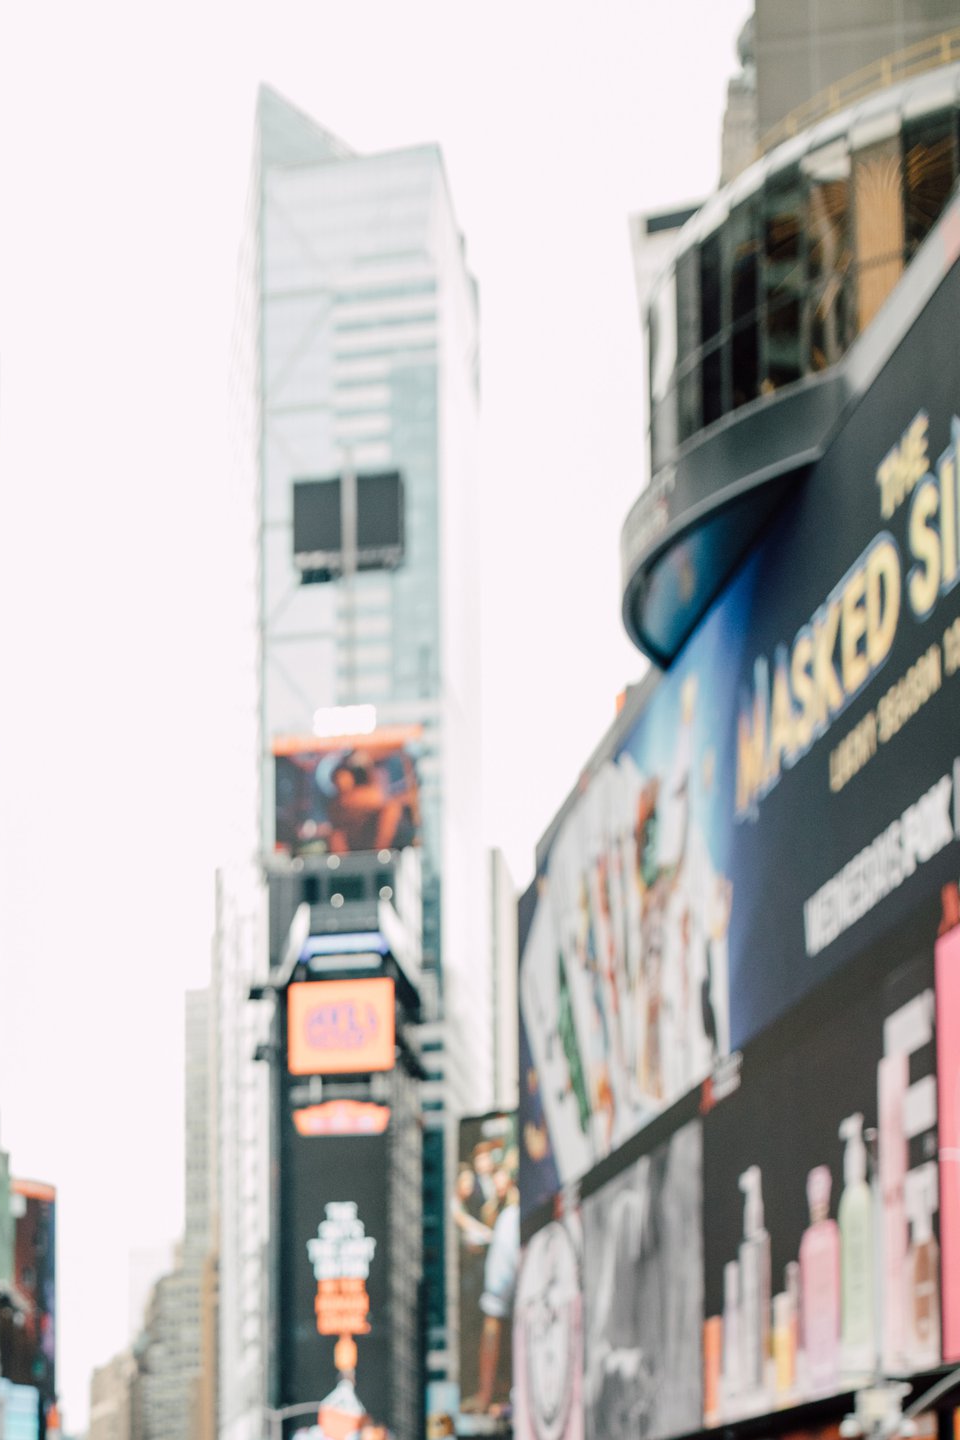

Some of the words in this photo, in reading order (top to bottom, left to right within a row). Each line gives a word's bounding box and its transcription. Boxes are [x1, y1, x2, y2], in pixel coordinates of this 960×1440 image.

[876, 406, 929, 520] THE
[734, 528, 901, 825] MASKED
[907, 412, 960, 622] SI
